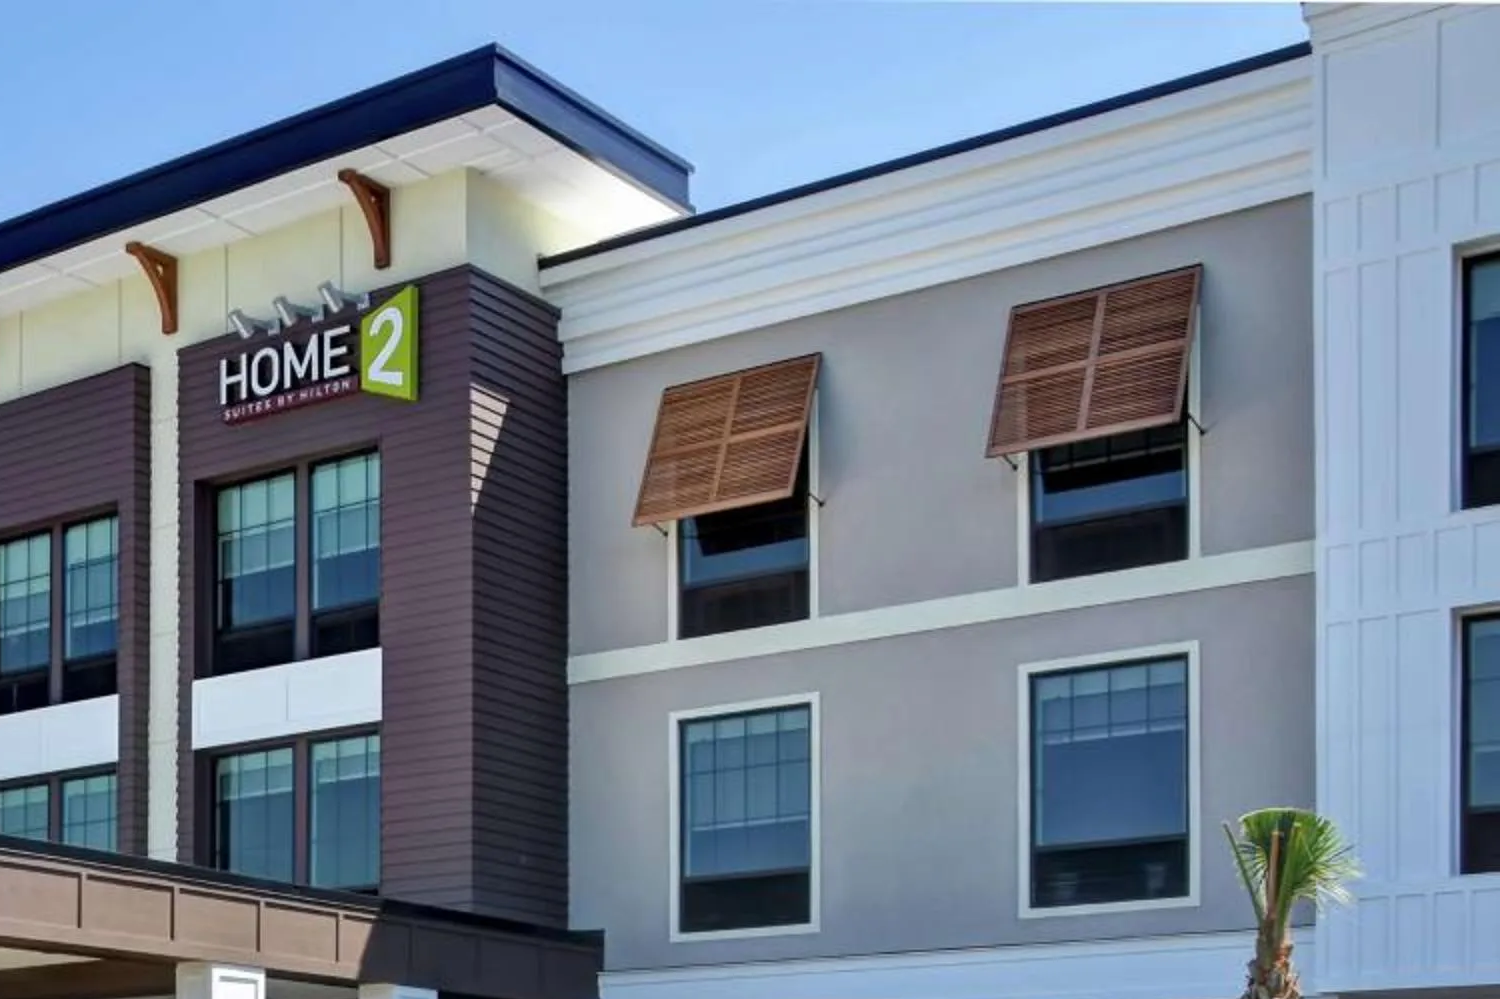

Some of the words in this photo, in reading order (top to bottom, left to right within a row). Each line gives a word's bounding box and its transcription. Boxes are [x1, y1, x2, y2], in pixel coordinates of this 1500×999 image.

[219, 324, 351, 405] HOME
[367, 306, 404, 387] 2
[224, 399, 272, 421] SUITES
[277, 392, 296, 407] BY
[299, 380, 350, 400] HILTON
